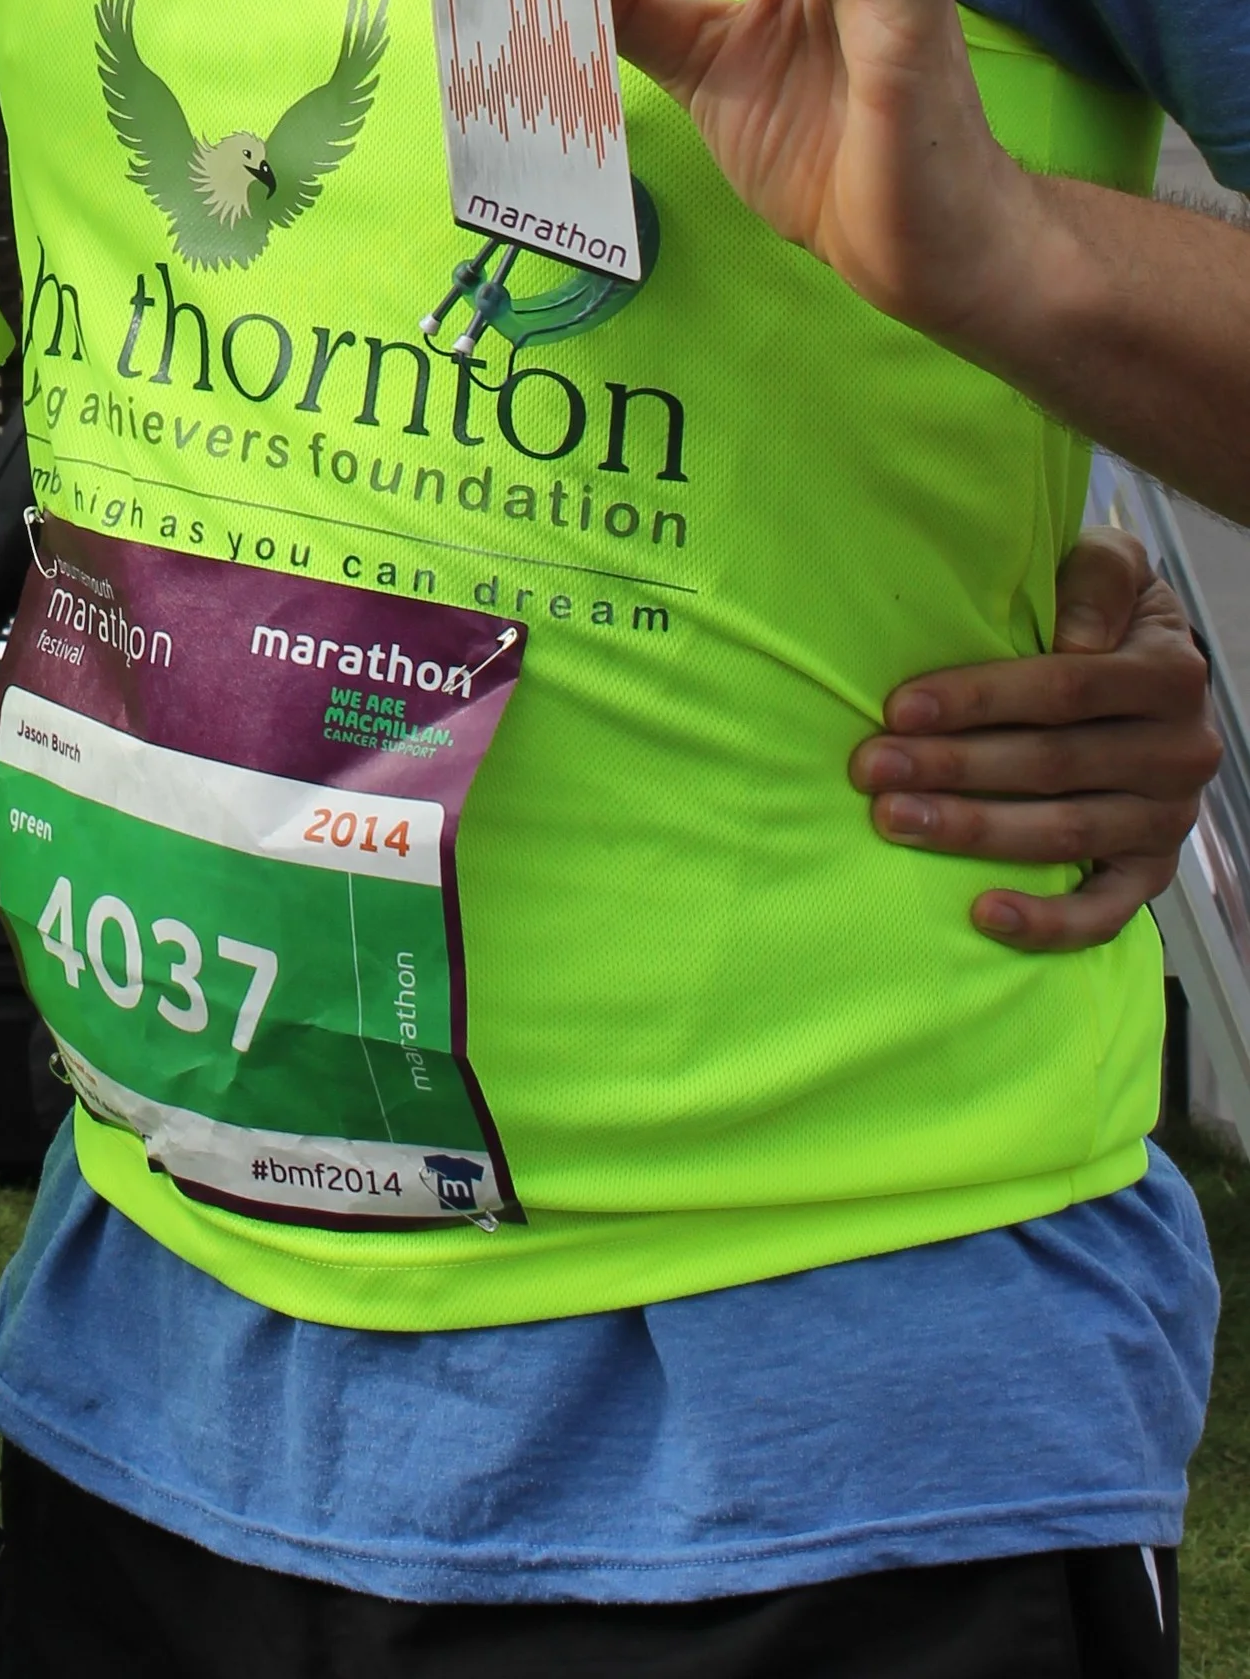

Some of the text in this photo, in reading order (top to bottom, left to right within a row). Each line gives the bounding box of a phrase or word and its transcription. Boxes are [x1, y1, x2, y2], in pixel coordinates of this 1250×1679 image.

[466, 193, 628, 269] marathon
[115, 263, 690, 483] thornton
[308, 433, 688, 549] foundation
[74, 481, 670, 633] high as you can dream
[36, 628, 86, 666] festival
[251, 625, 472, 699] marathon
[330, 686, 406, 719] WE ARE
[17, 719, 81, 763] Jason Burch
[323, 727, 437, 759] CANCER SUPPORT
[10, 808, 53, 842] green
[303, 807, 411, 858] 2014
[36, 875, 279, 1054] 4037
[393, 950, 433, 1092] marathon
[252, 1157, 403, 1197] #bmf2014
